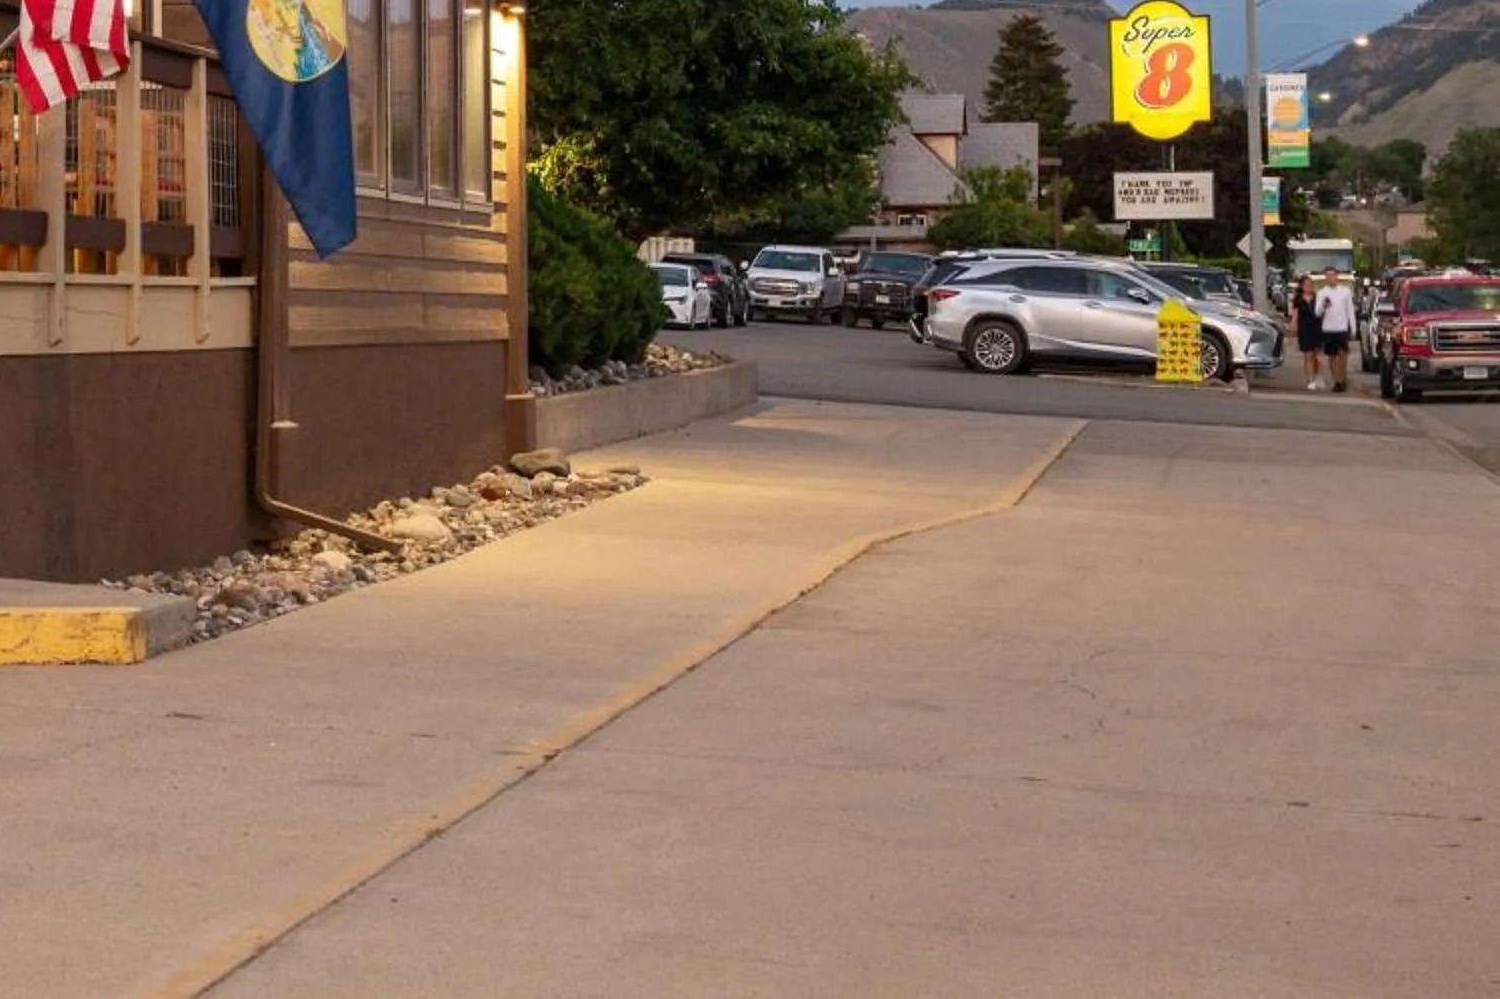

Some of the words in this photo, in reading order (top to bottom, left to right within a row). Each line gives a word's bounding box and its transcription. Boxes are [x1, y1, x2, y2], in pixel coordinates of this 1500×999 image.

[1123, 15, 1196, 54] Super
[1134, 42, 1195, 109] 8
[1121, 196, 1137, 204] YOU
